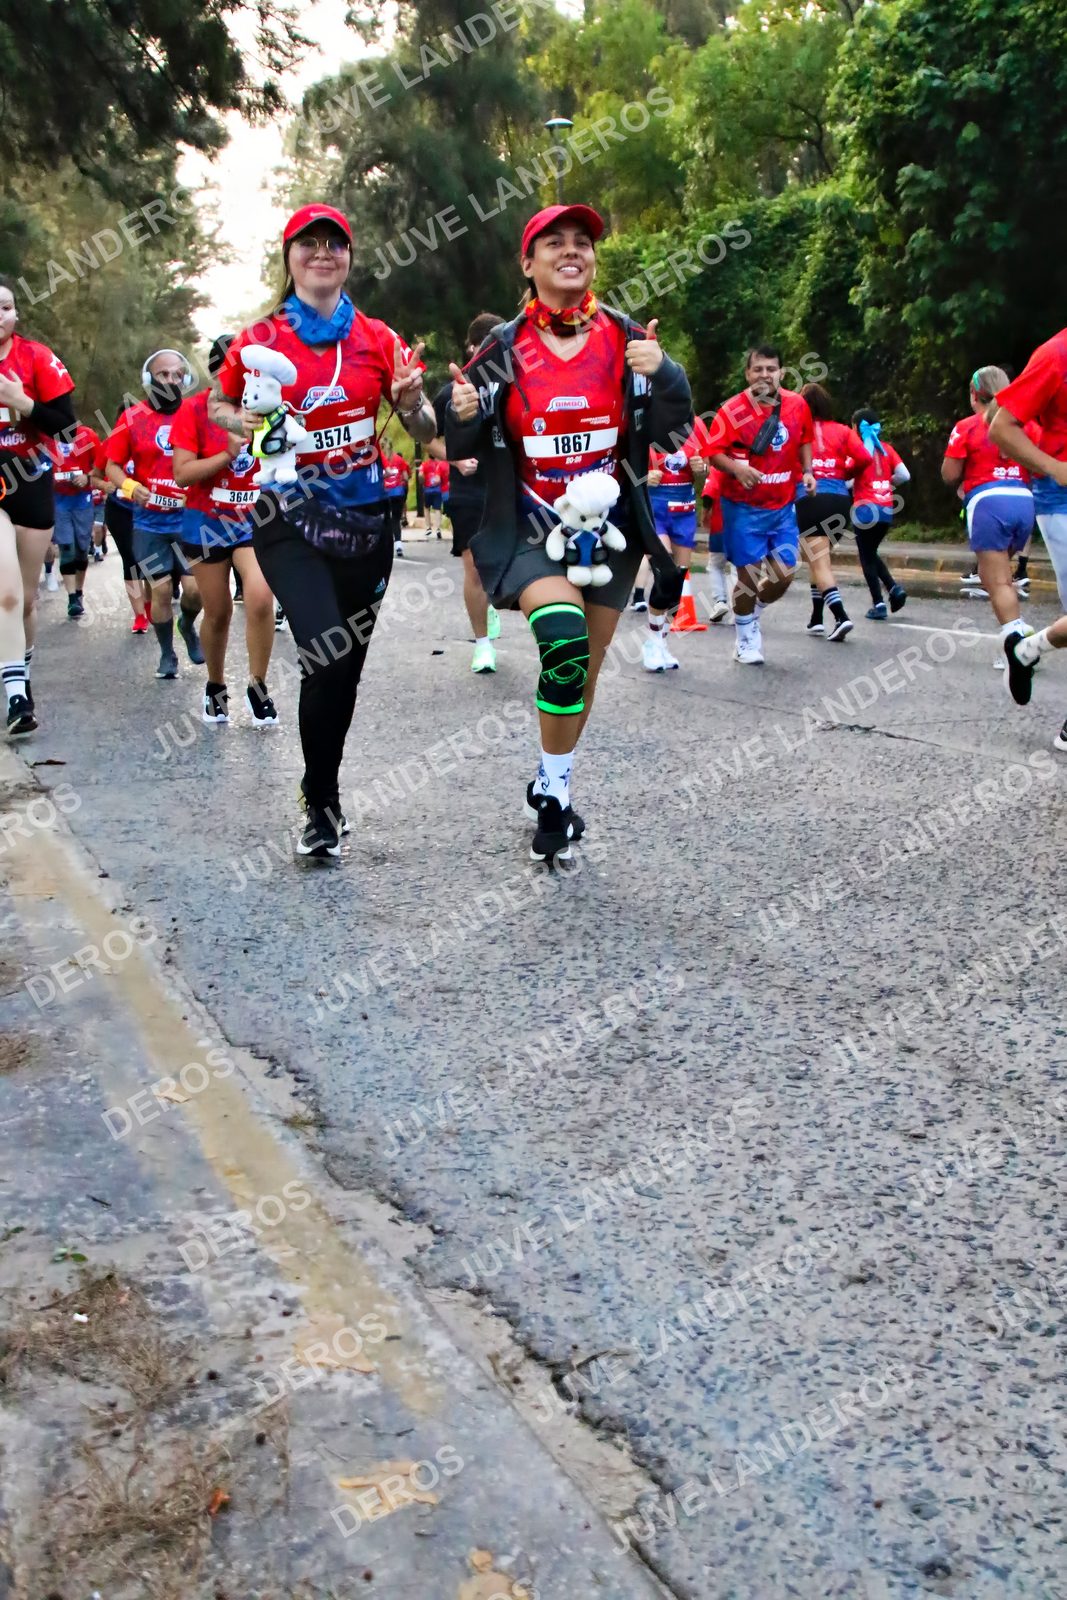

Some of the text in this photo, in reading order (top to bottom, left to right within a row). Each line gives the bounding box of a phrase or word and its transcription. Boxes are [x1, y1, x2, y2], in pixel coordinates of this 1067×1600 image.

[313, 425, 352, 450] 3574
[553, 433, 591, 455] 1867
[229, 491, 254, 503] 3644
